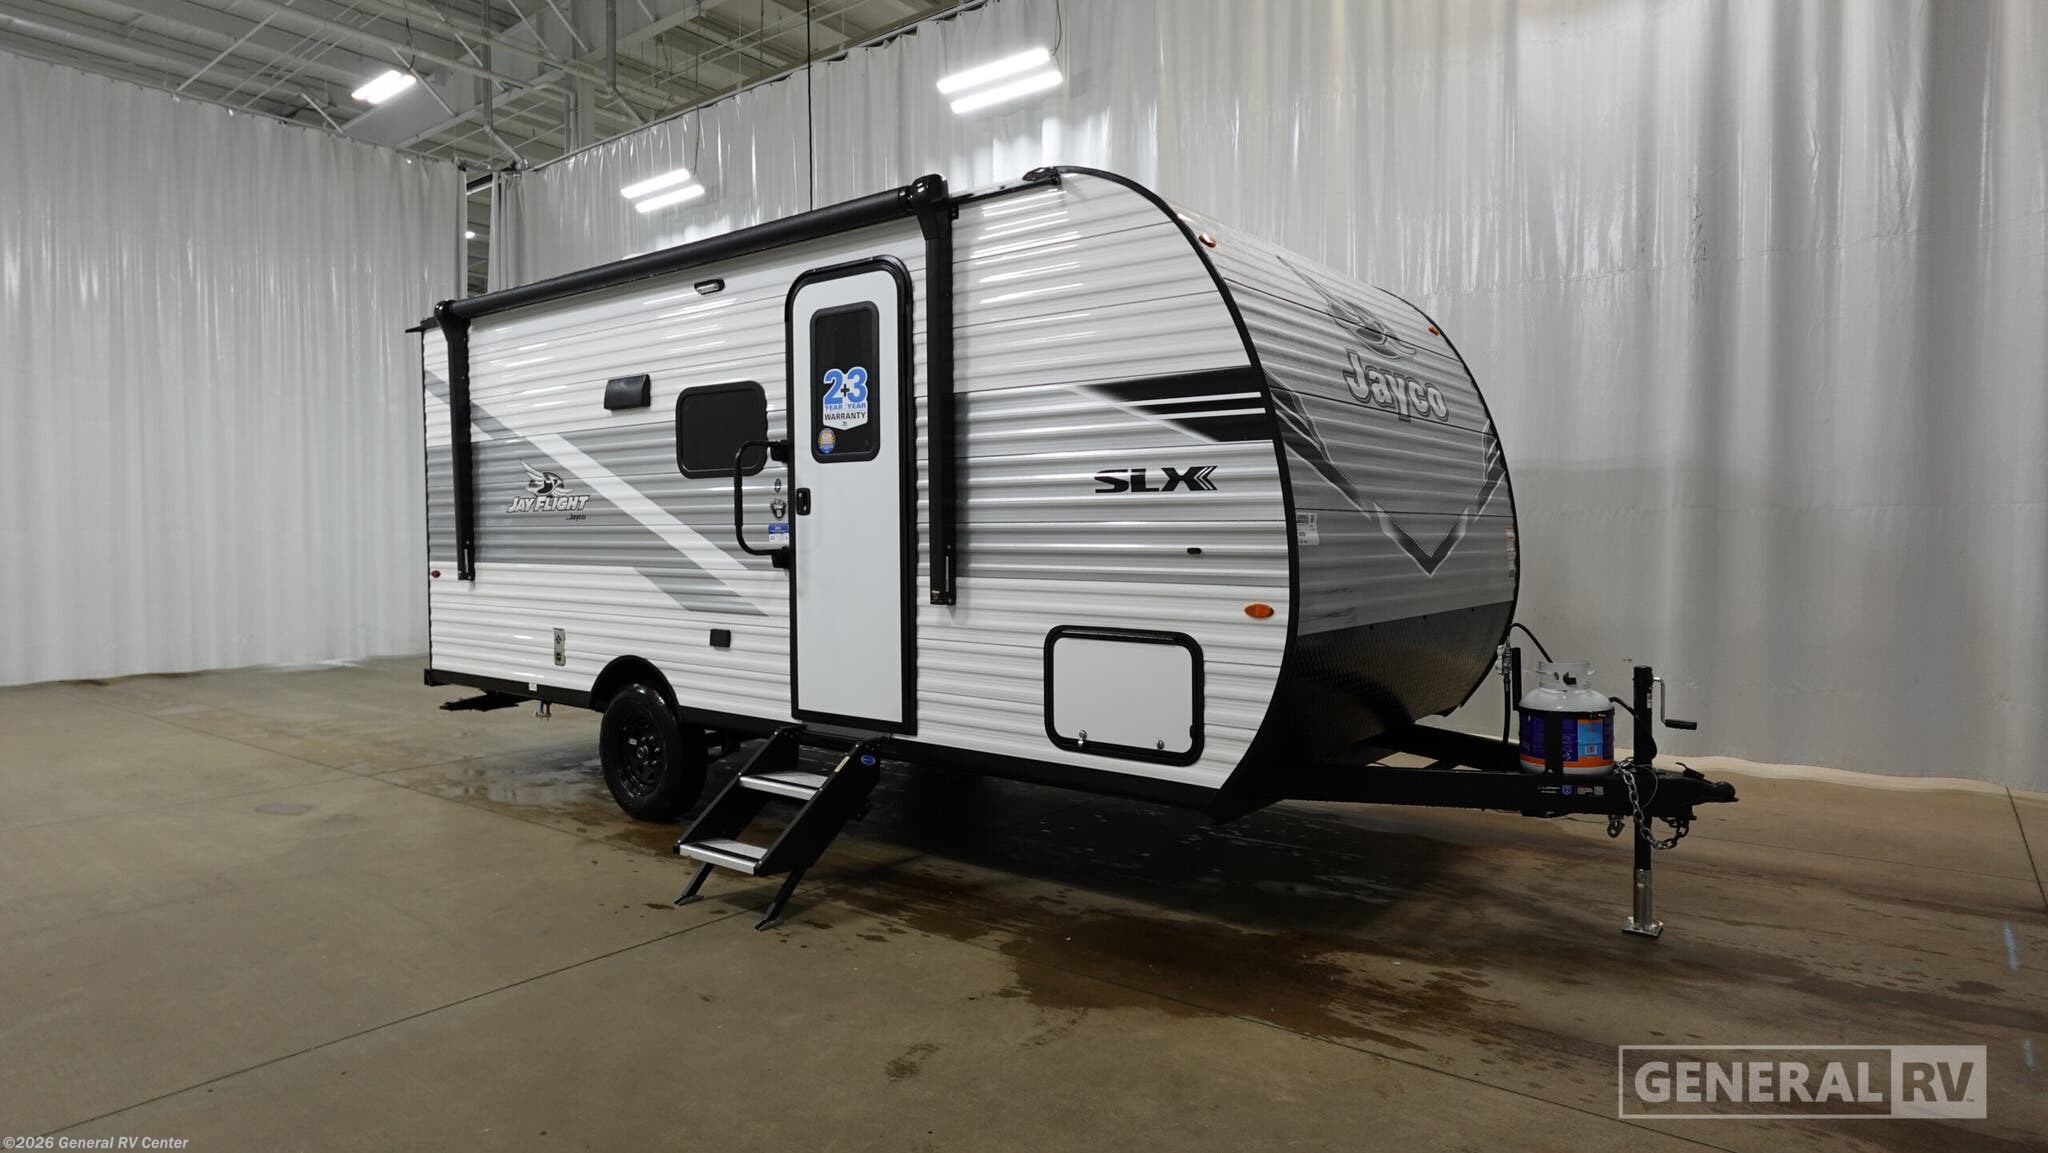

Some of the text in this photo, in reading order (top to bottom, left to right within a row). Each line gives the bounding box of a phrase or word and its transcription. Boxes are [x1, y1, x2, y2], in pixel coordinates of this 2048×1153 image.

[1343, 348, 1448, 422] Jayco
[847, 402, 867, 410] YEAR
[824, 411, 866, 421] WARRANTY
[1094, 465, 1218, 494] SLX
[507, 495, 590, 513] JAY FLIGHT
